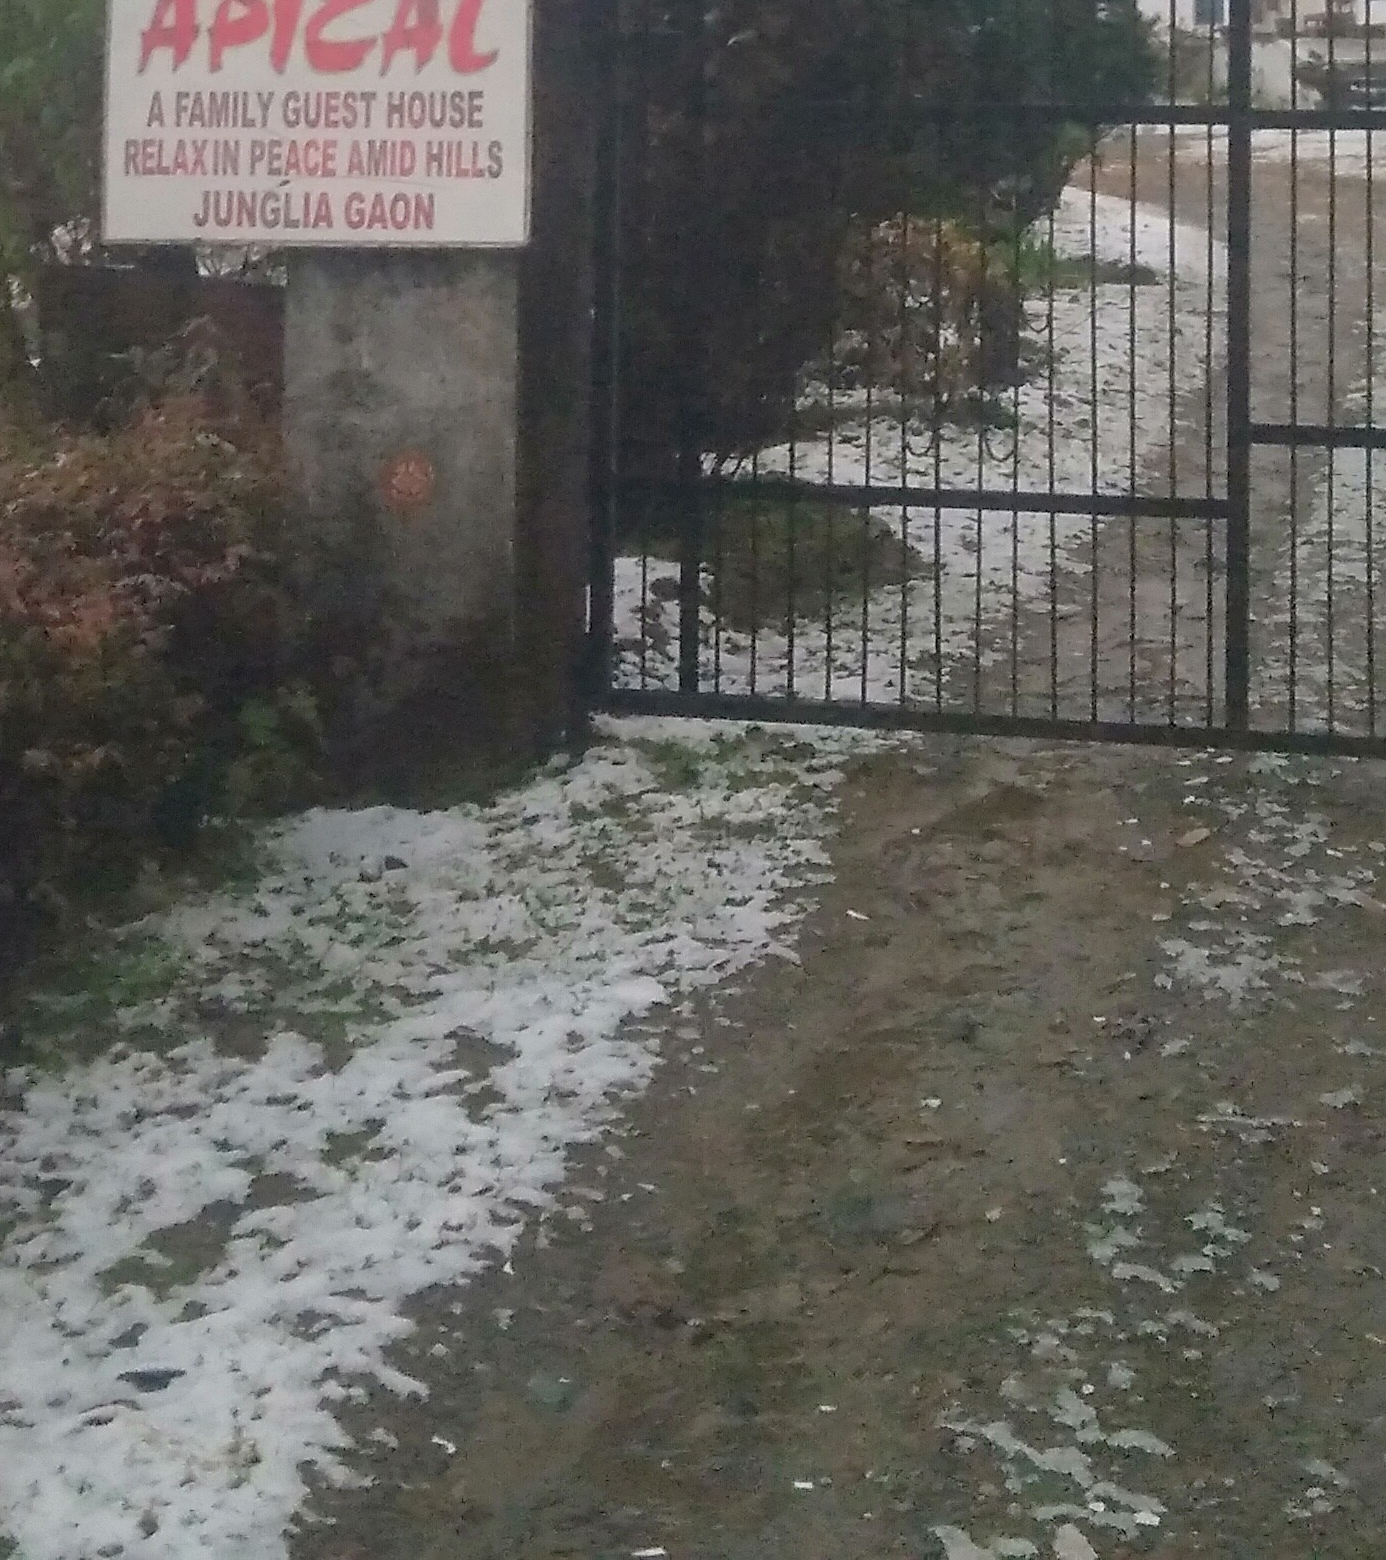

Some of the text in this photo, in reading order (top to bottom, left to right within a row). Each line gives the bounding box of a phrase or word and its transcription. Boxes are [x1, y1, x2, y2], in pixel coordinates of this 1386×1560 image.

[146, 90, 484, 128] A FAMILY GUEST HOUSE
[249, 139, 337, 177] PEACE
[347, 140, 415, 177] AMID
[425, 140, 503, 179] HILLS
[193, 191, 435, 230] JUNGLIA GAON
